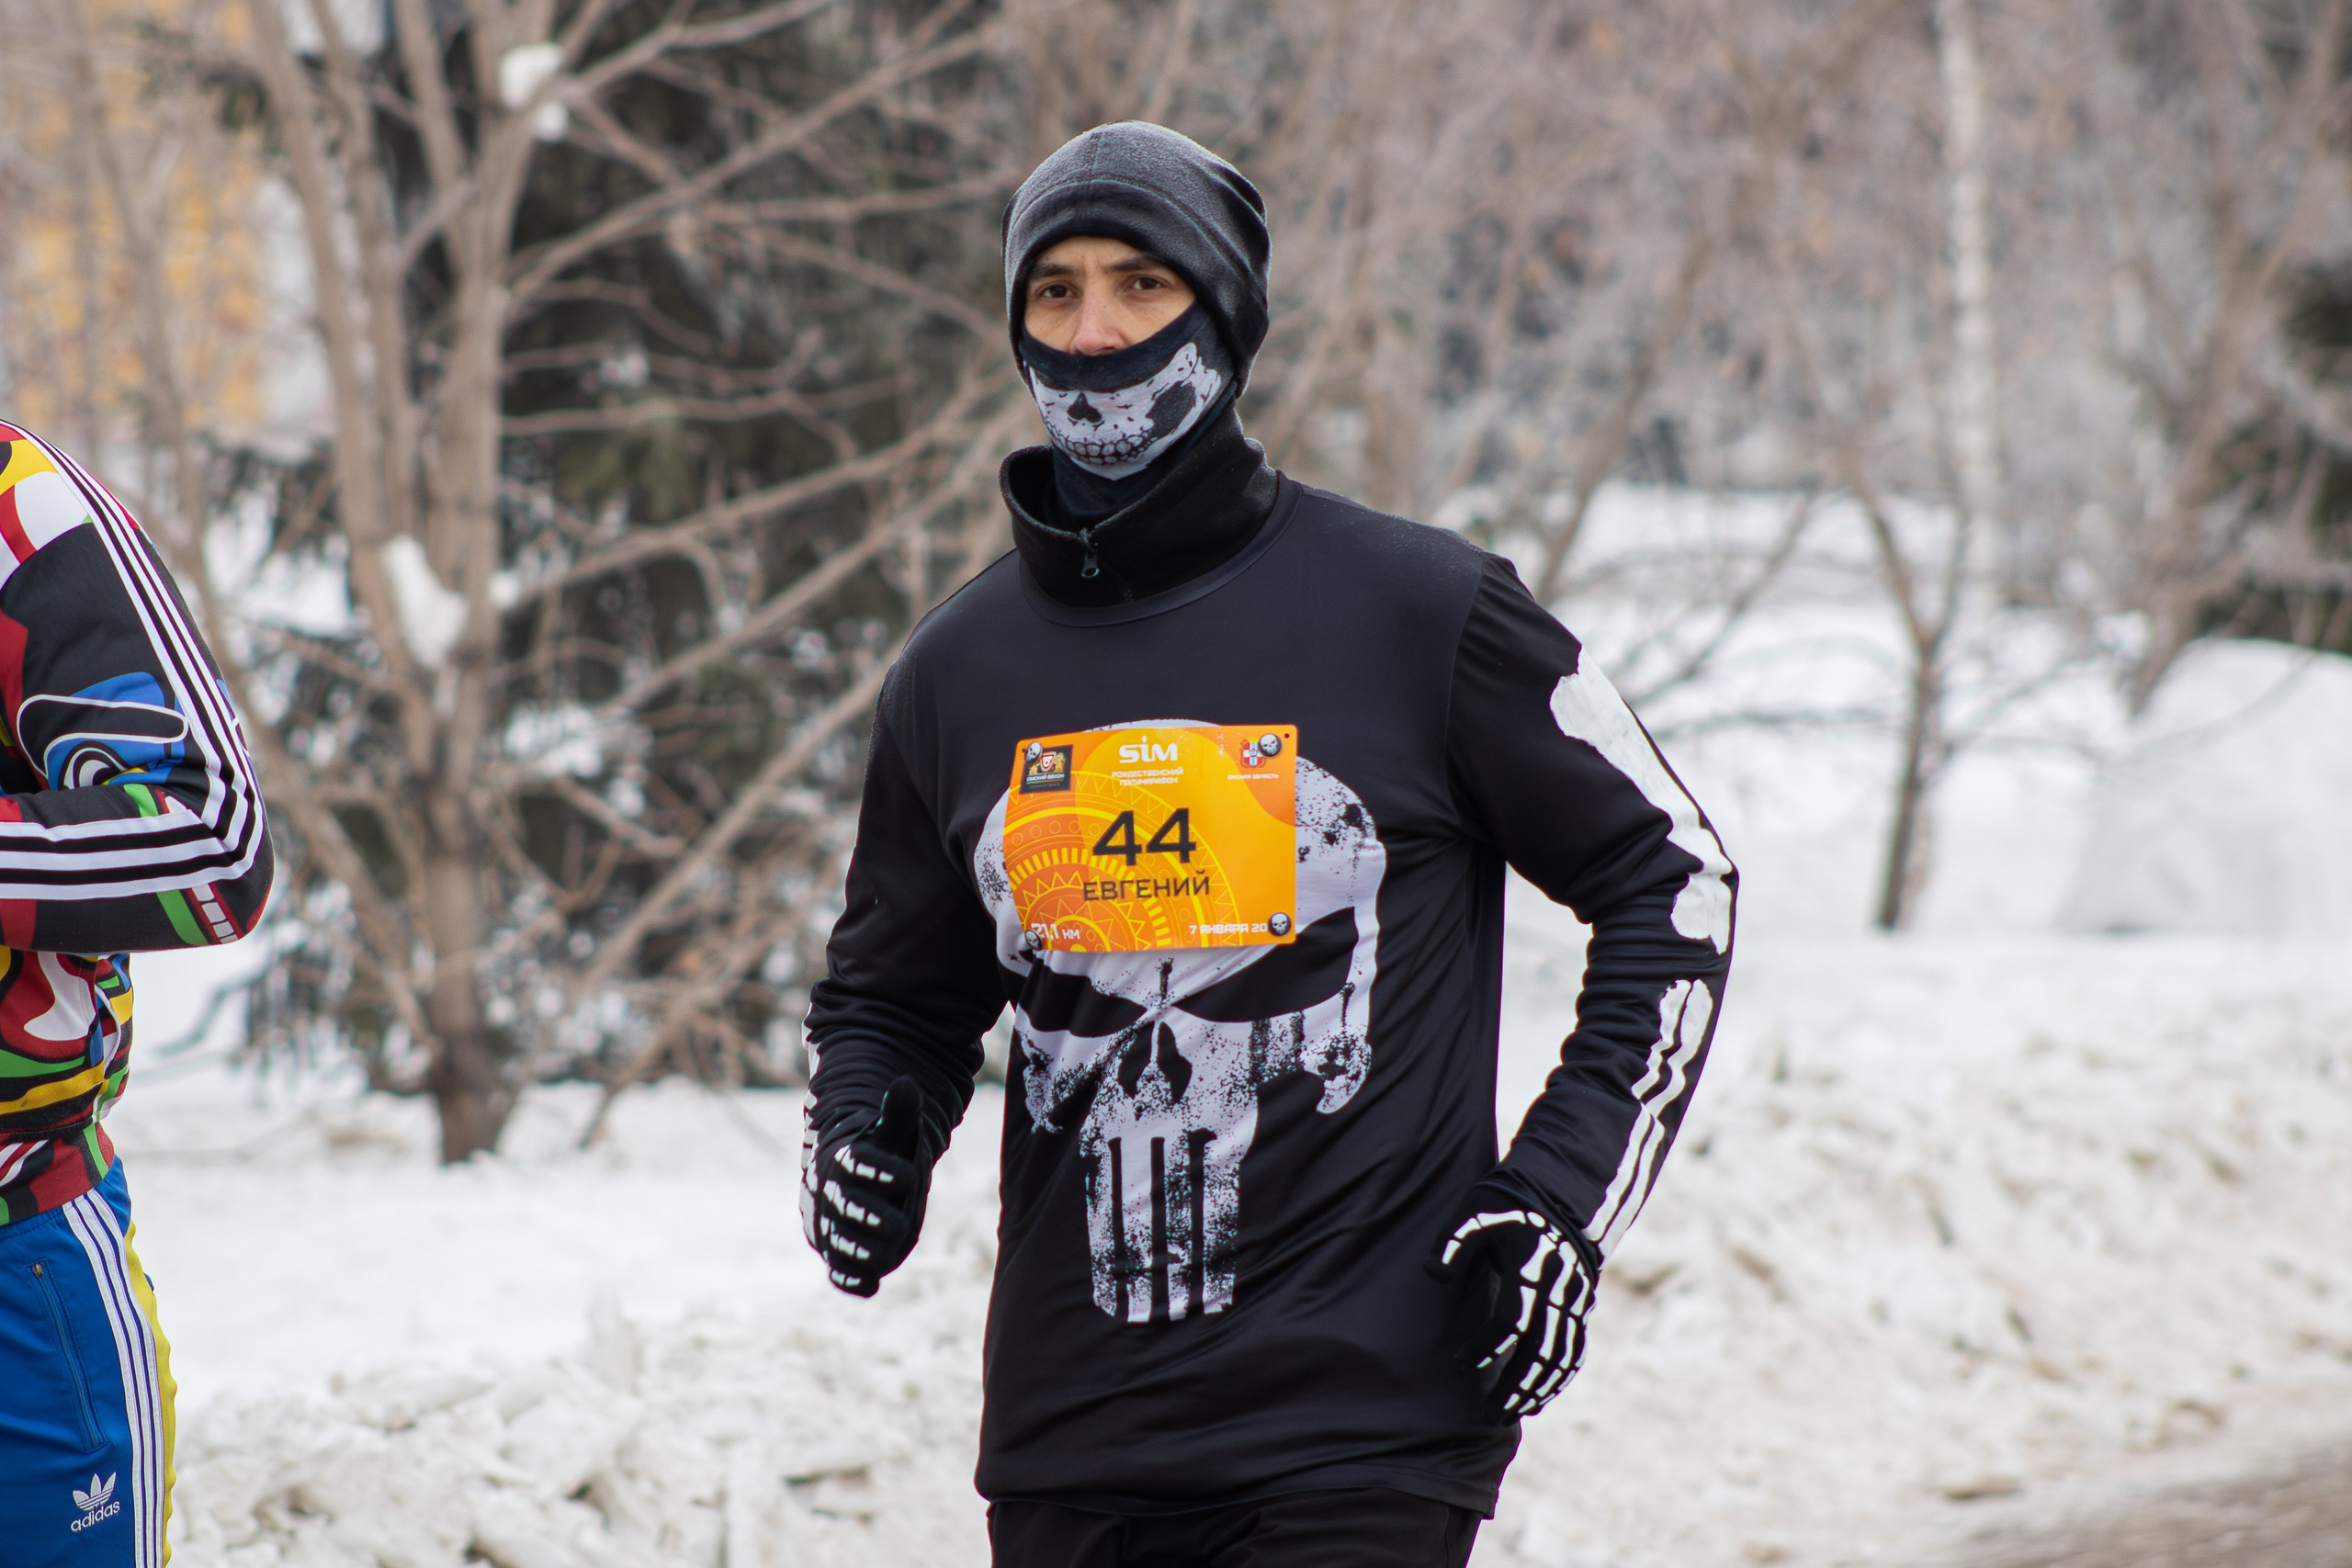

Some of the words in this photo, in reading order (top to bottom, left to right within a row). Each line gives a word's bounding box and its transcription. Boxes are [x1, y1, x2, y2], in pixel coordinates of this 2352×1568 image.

[1111, 766, 1184, 779] РОЖДЕСТВЕНСКИЙ
[1119, 777, 1178, 786] ПОЛУМАРАФОН
[1092, 807, 1196, 866] 44
[1083, 869, 1209, 901] ЕВГЕНИЙ
[1189, 924, 1198, 935] 7
[1199, 923, 1250, 934] ЯНВАРЯ
[1250, 922, 1268, 933] 20
[70, 1500, 120, 1532] adidas
